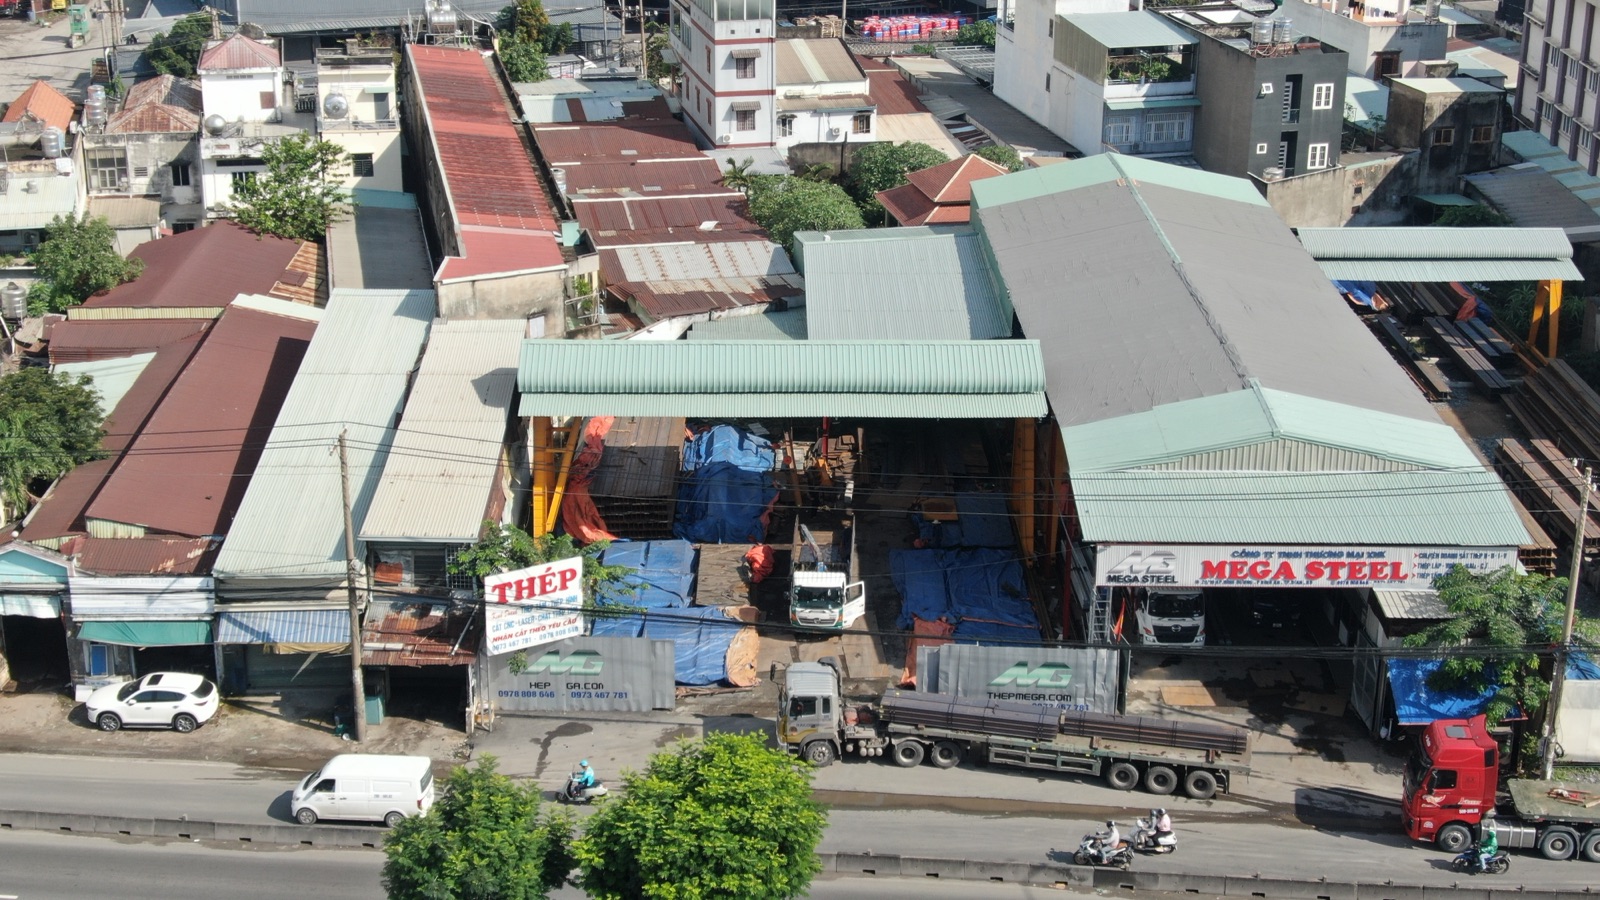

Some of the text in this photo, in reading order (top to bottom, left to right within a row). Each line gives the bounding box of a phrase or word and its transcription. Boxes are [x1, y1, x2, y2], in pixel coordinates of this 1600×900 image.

[1230, 548, 1260, 558] CÔNG
[1263, 551, 1275, 559] TY
[1200, 560, 1408, 581] MEGA STEEL
[1107, 574, 1178, 583] MEGA STEEL
[491, 567, 577, 604] THÉP
[504, 621, 514, 630] CNC
[518, 615, 535, 626] LASER
[529, 625, 546, 634] THEO
[492, 642, 506, 651] 0973
[521, 649, 604, 676] MG
[986, 661, 1072, 688] MG
[987, 692, 1071, 702] THEPMEGA.COM
